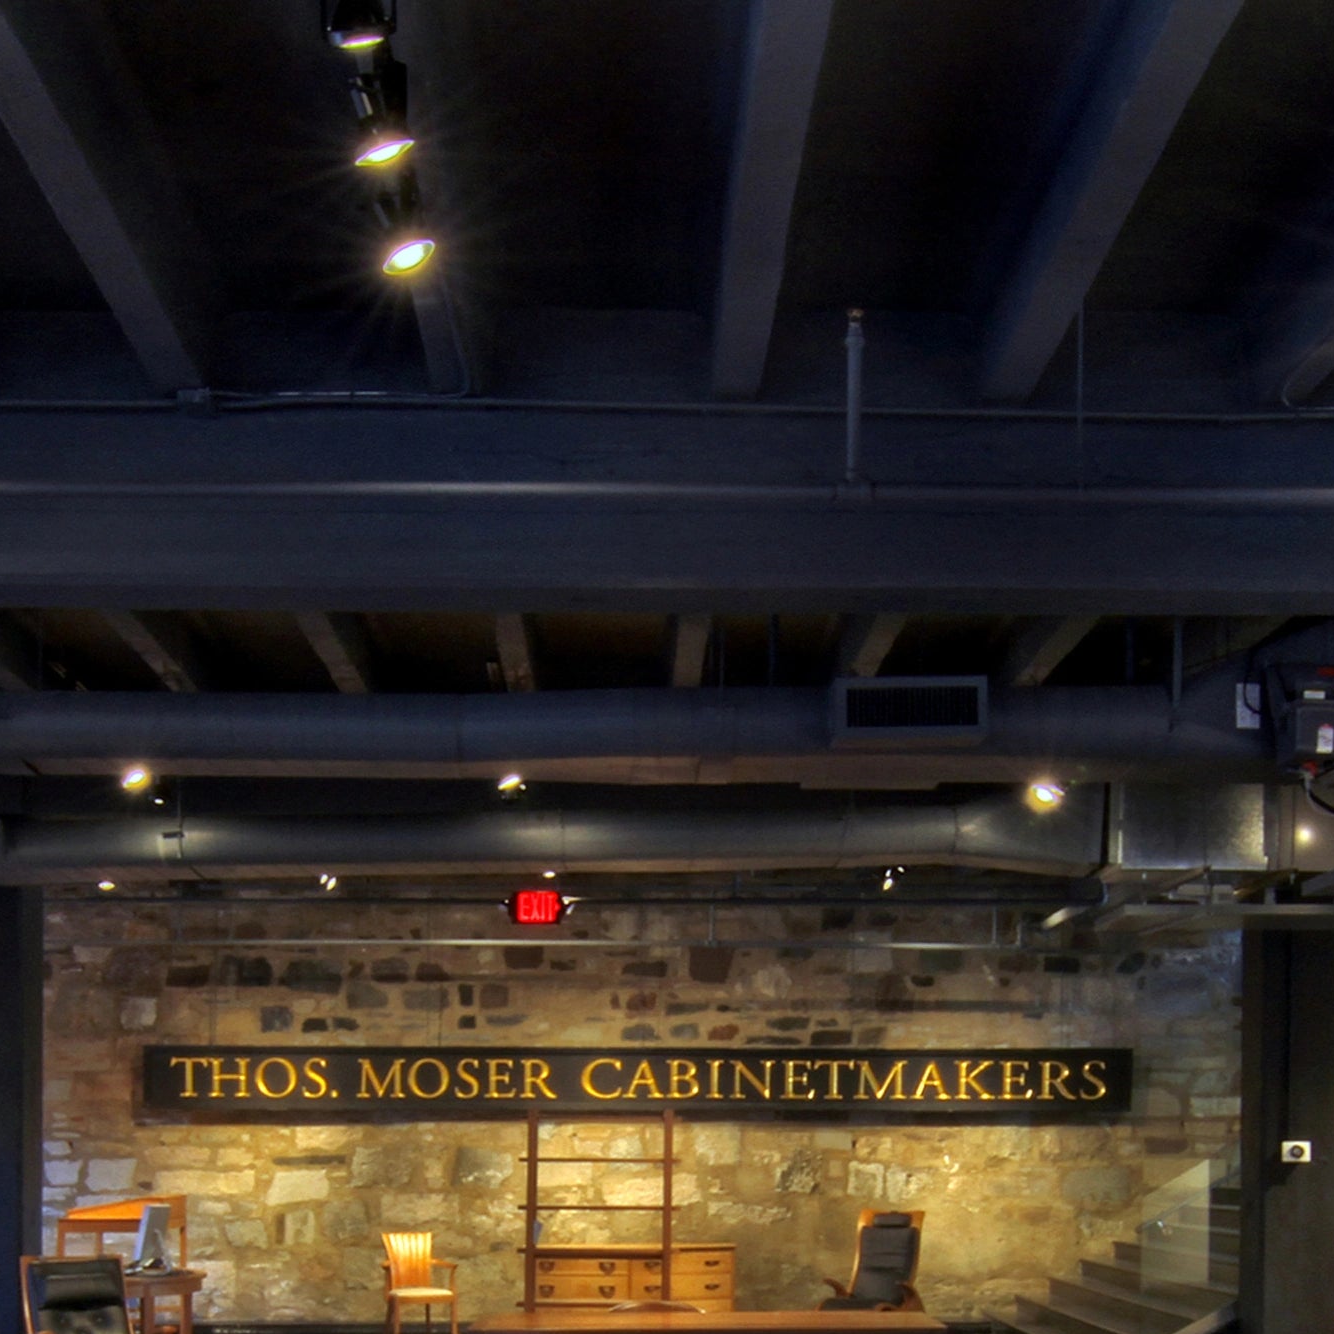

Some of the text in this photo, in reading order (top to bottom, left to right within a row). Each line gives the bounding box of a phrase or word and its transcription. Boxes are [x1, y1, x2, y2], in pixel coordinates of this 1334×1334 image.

[519, 893, 554, 921] EXIT
[169, 1056, 1107, 1100] THOS. MOSER CABINETMAKERS
